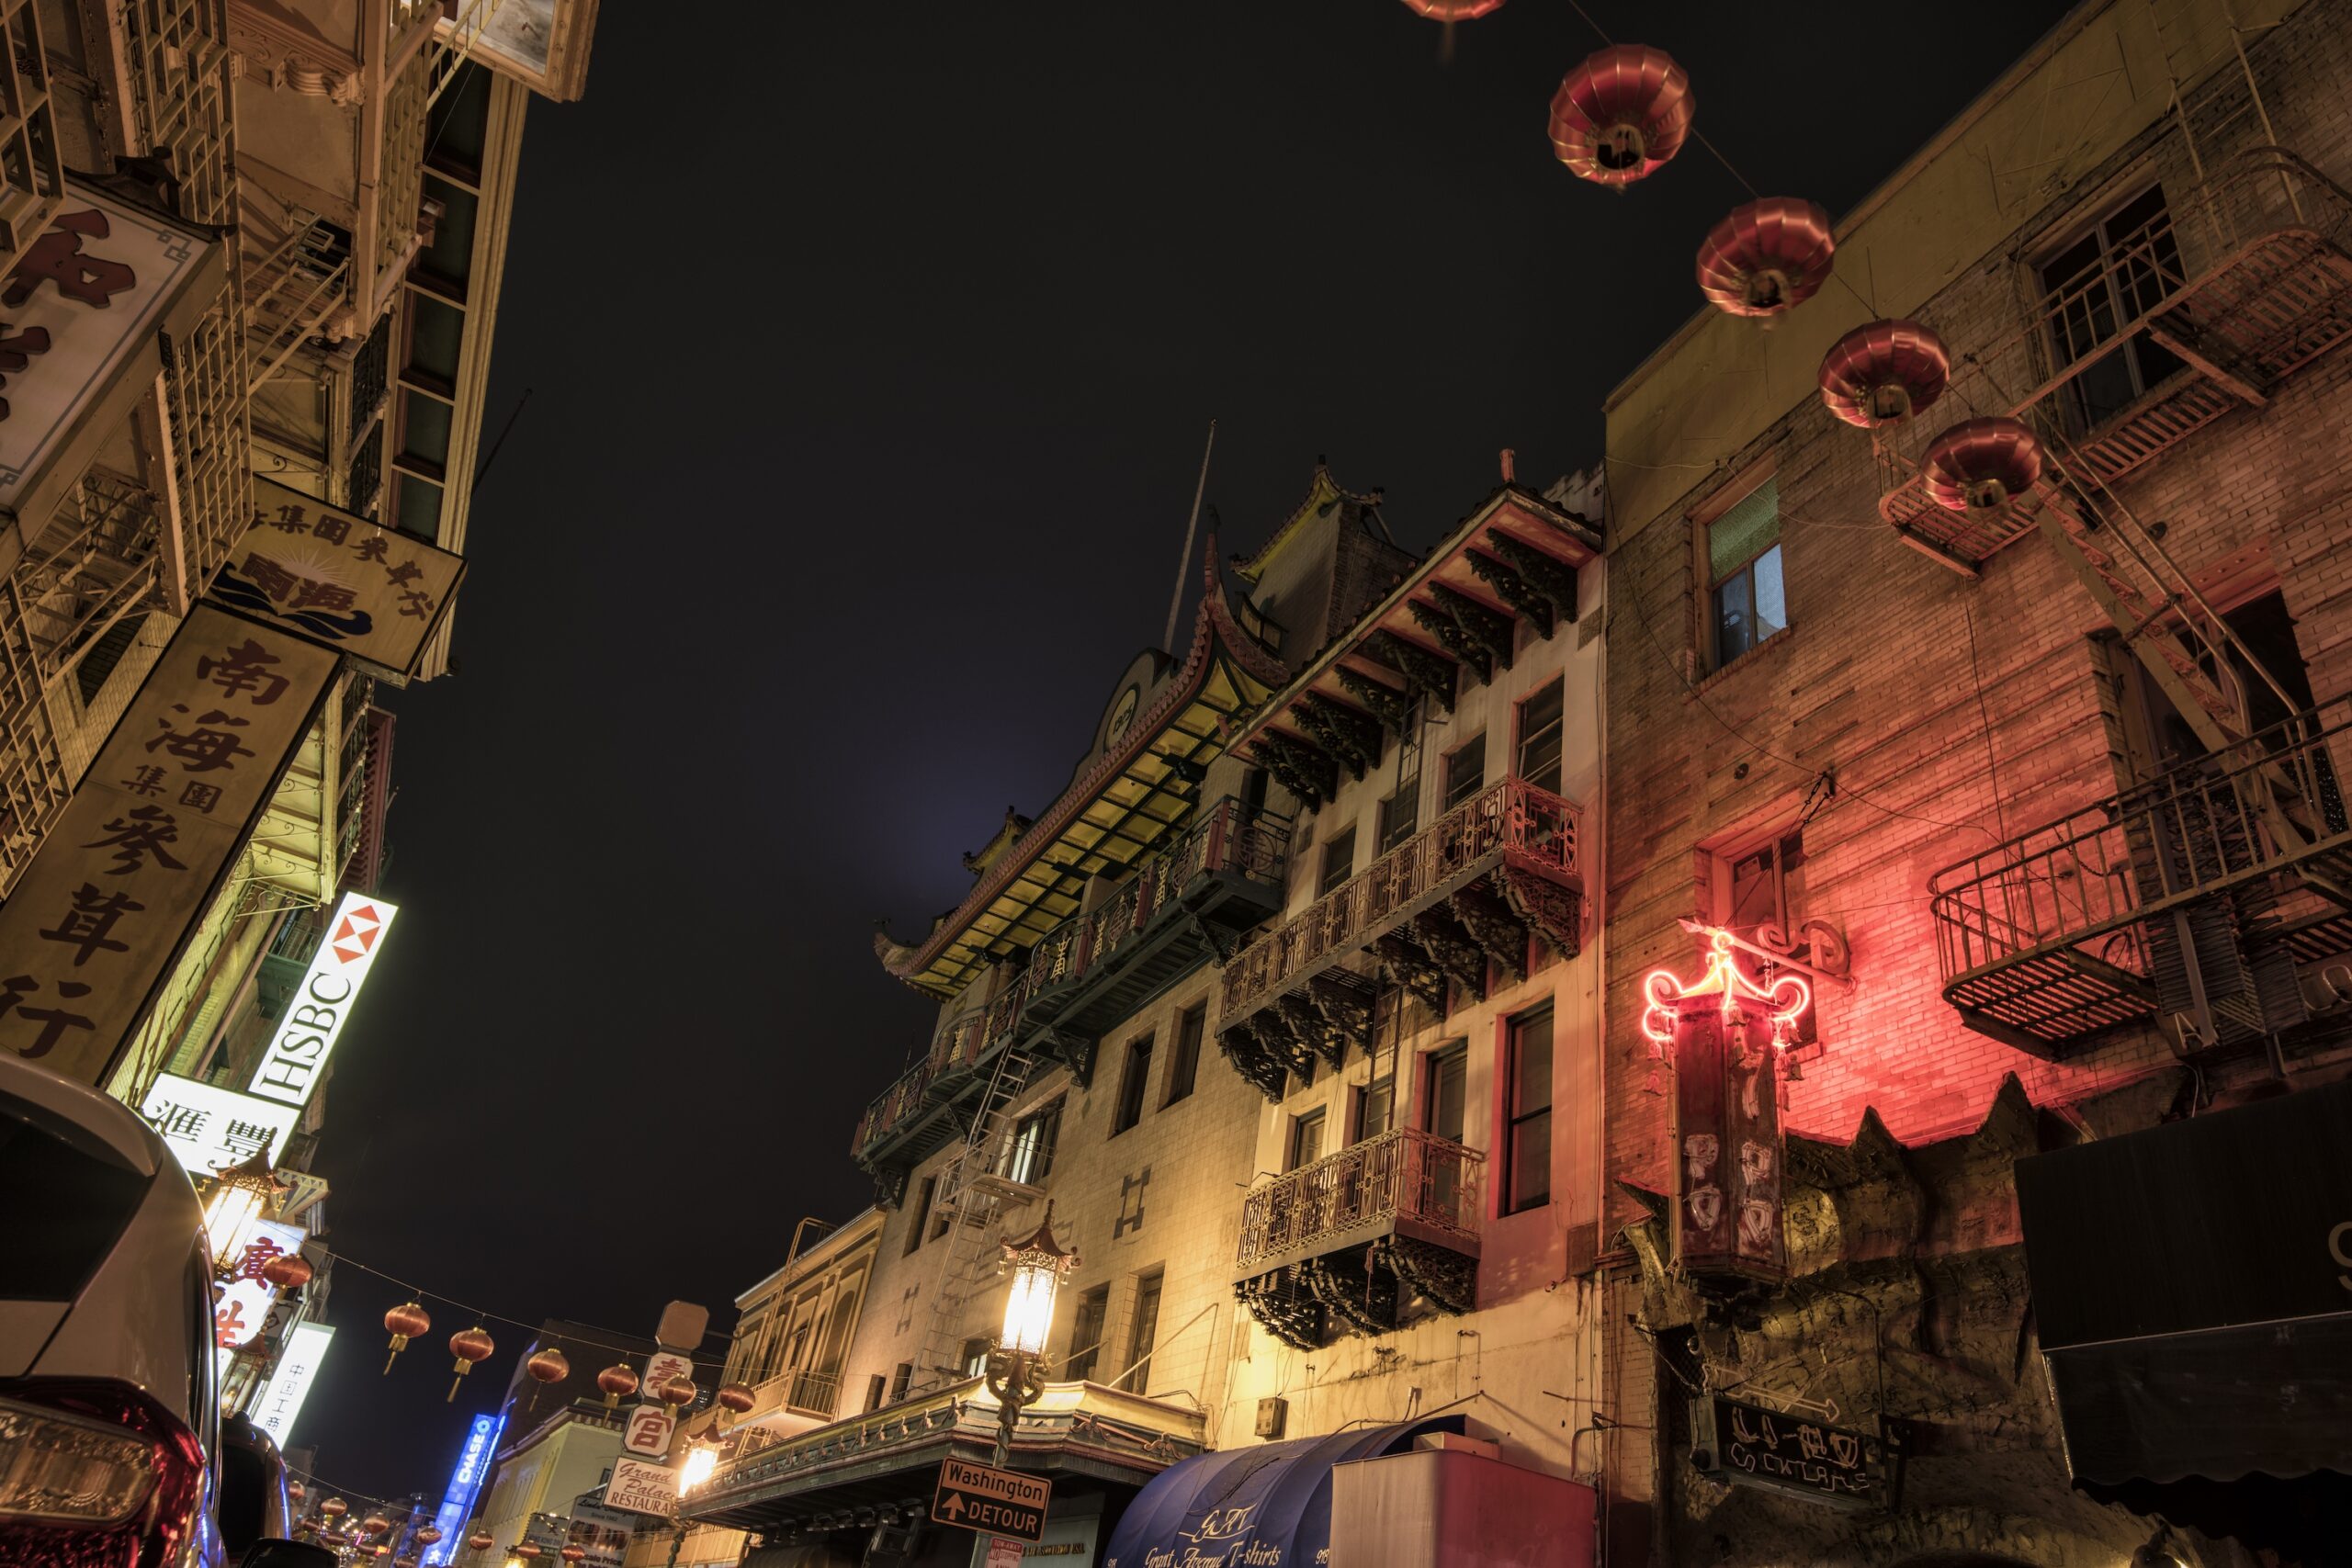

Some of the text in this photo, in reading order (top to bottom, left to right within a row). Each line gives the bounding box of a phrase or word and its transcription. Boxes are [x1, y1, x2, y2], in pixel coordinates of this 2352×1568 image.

[260, 971, 352, 1098] HSBC
[458, 1433, 486, 1484] CHASE
[619, 1462, 673, 1483] Grand
[949, 1463, 1043, 1502] Washington
[611, 1492, 671, 1516] RESTAURA
[968, 1501, 1037, 1533] DETOUR
[1228, 1540, 1281, 1565] T-shirts
